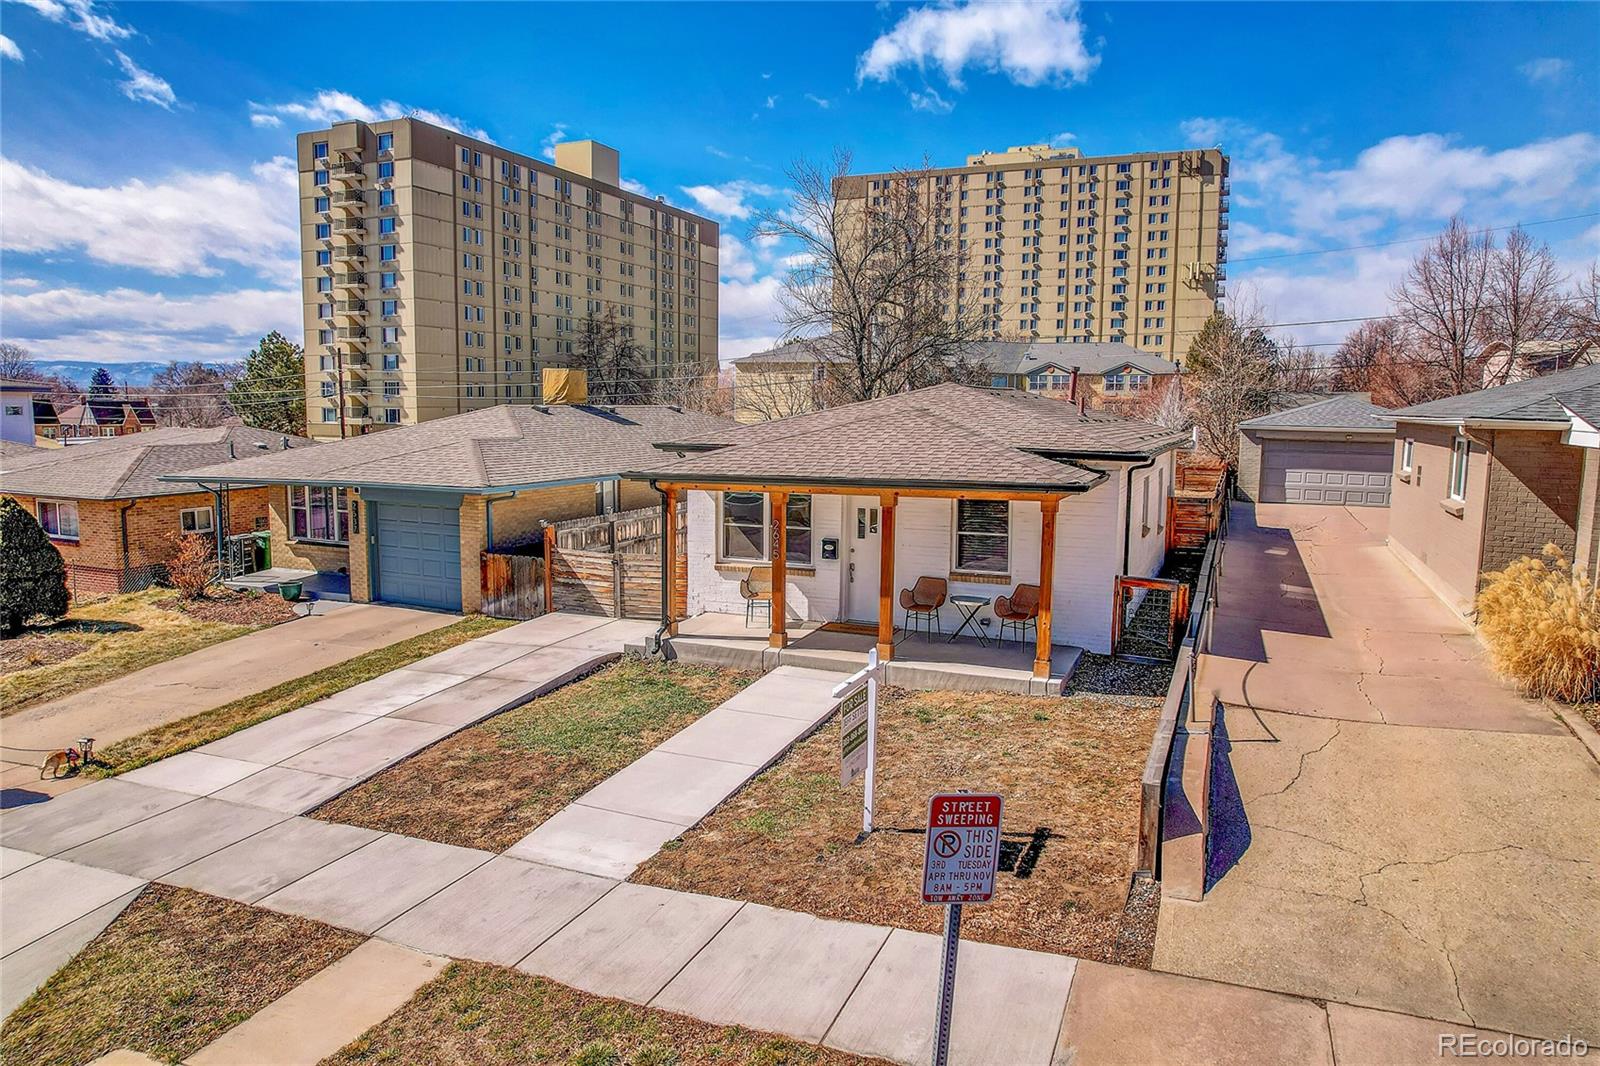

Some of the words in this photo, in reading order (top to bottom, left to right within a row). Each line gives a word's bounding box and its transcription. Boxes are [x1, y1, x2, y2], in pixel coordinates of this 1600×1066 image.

[854, 690, 866, 707] SALE
[942, 802, 991, 812] STREET
[937, 814, 993, 825] SWEEPING
[966, 830, 994, 843] THIS
[964, 845, 992, 858] SIDE
[931, 860, 946, 869] 3RD
[958, 860, 992, 869] TUESDAY
[929, 872, 946, 881] APR
[949, 871, 970, 881] THRU
[974, 871, 991, 880] NOV
[933, 883, 952, 892] 8AM
[964, 882, 983, 891] 5PM
